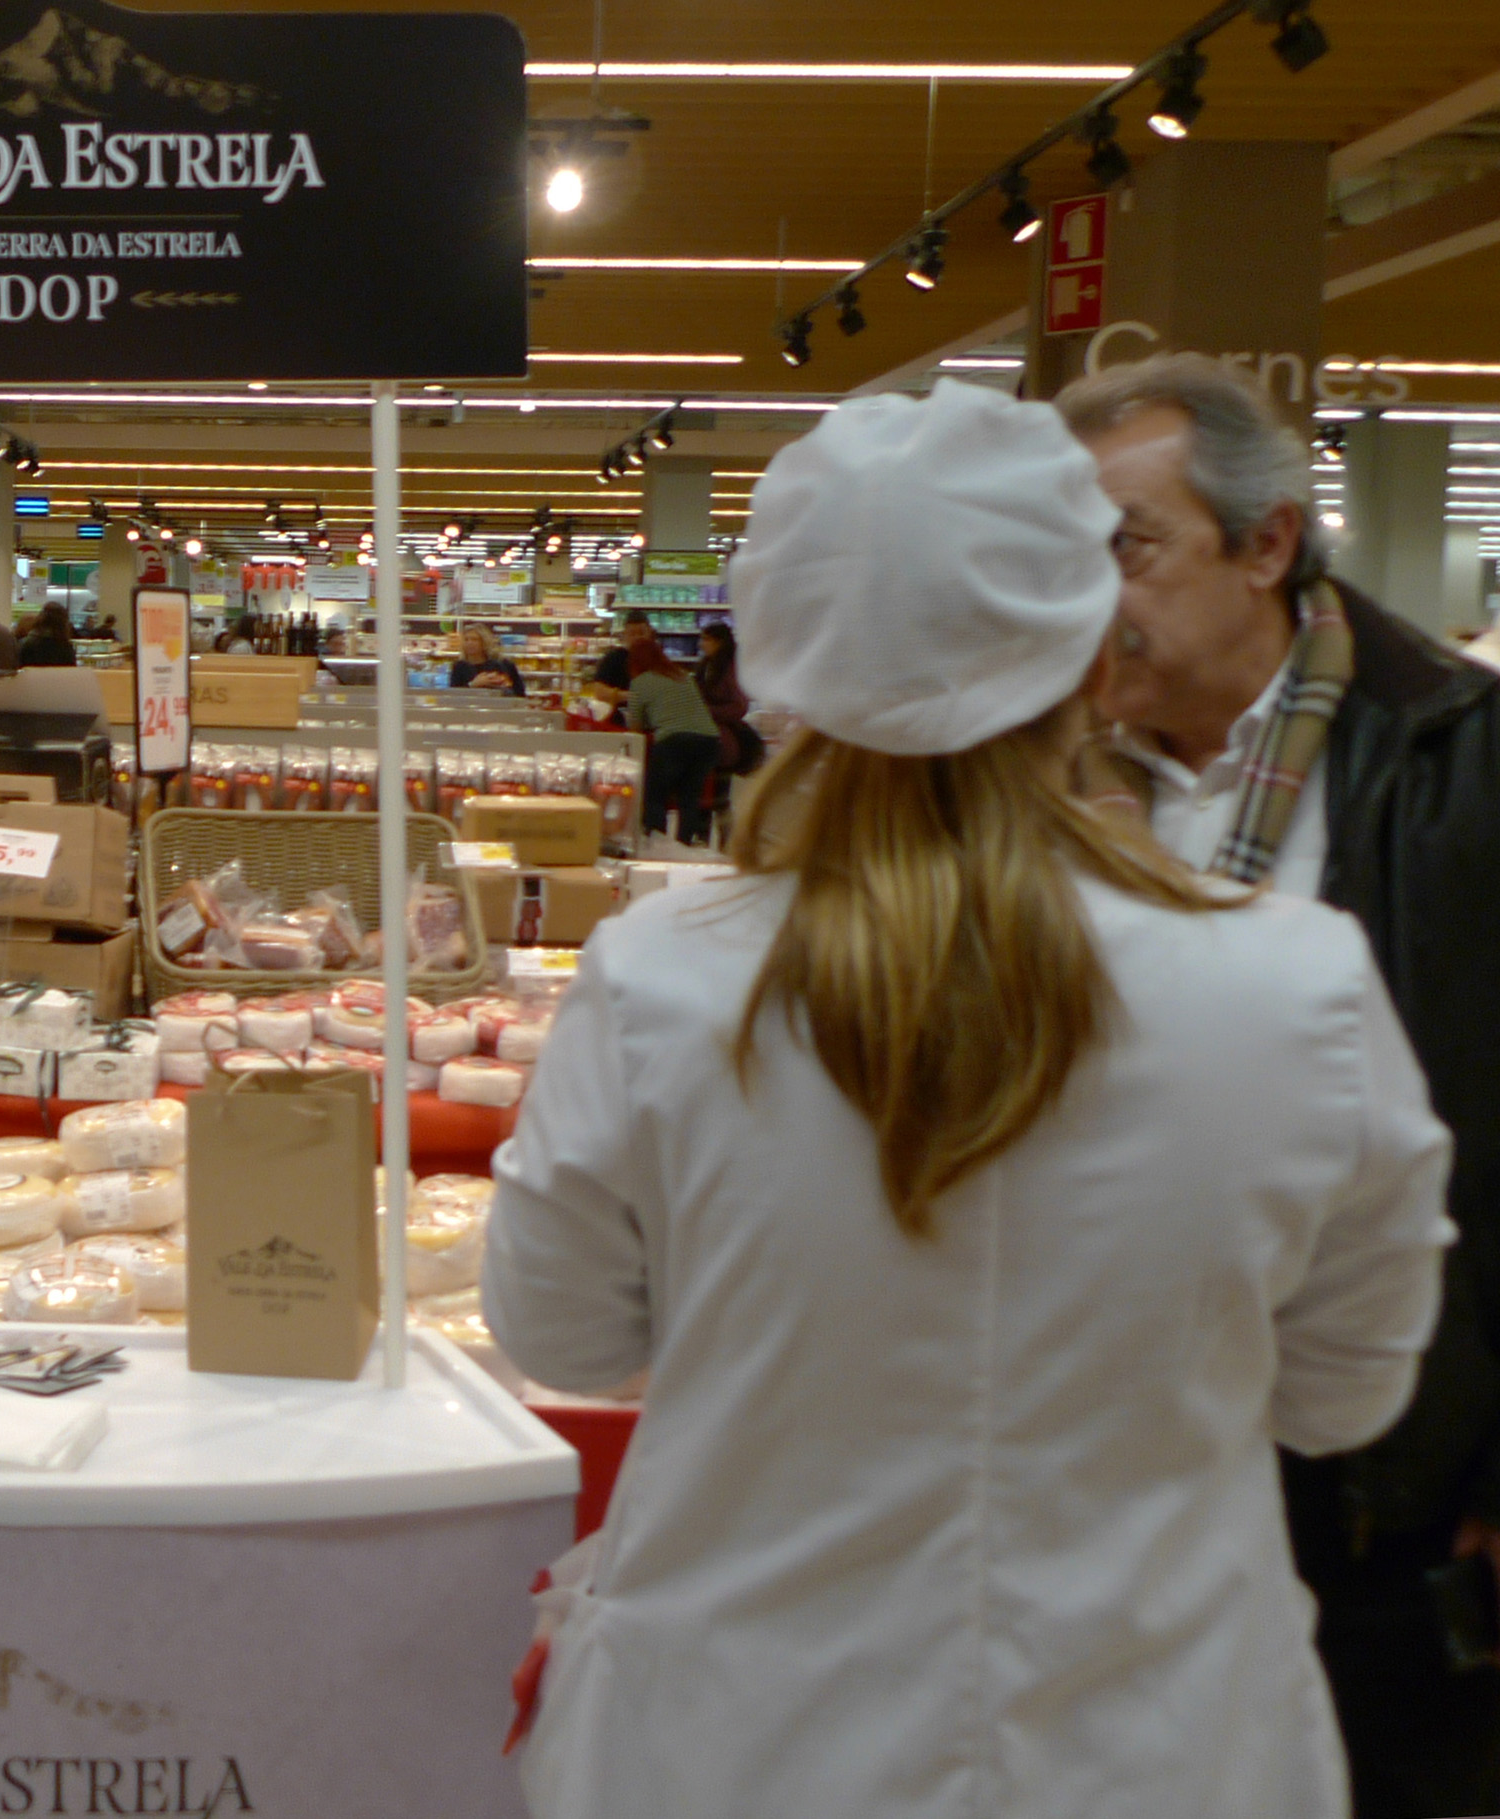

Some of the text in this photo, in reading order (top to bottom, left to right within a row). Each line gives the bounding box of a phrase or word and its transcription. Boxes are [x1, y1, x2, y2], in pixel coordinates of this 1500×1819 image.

[60, 121, 327, 204] ESTRELA
[71, 232, 114, 259] DA
[117, 232, 243, 259] ESTRELA
